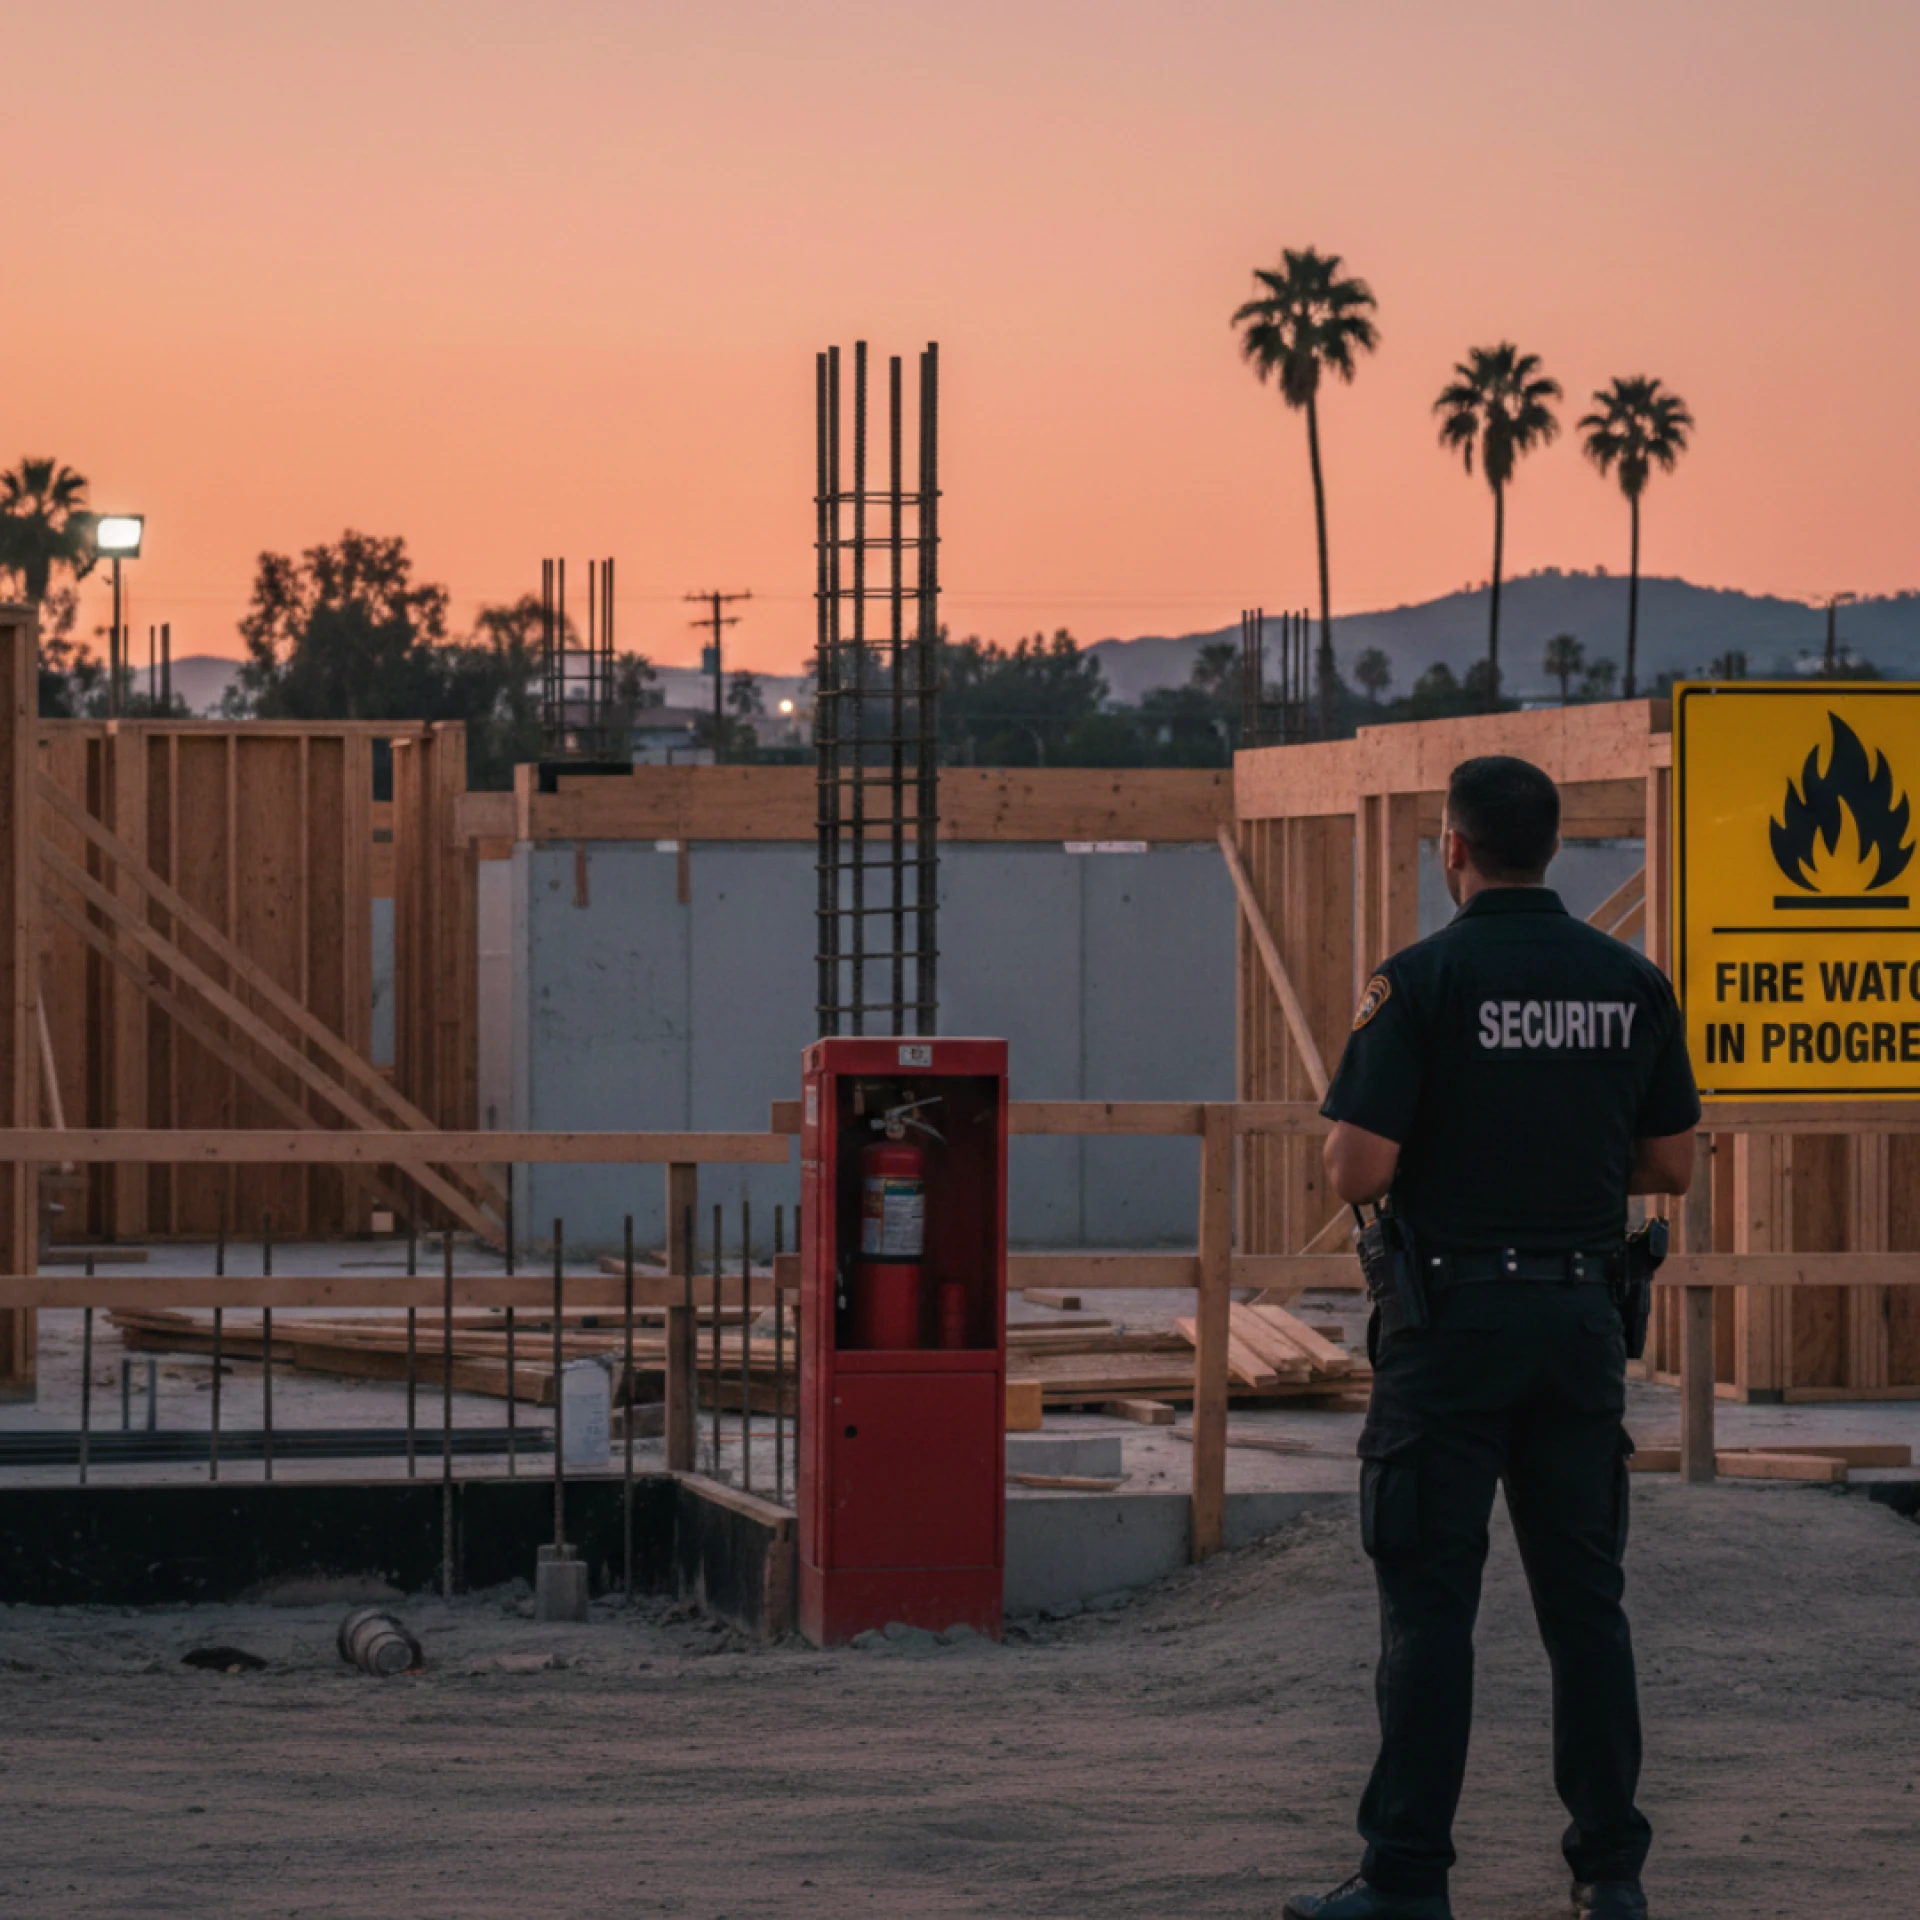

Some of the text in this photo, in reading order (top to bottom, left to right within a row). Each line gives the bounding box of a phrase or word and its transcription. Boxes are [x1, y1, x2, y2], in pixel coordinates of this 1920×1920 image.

[1716, 961, 1804, 1003] FIRE
[1478, 1000, 1636, 1050] SECURITY
[1705, 1021, 1920, 1065] IN PROGRE
